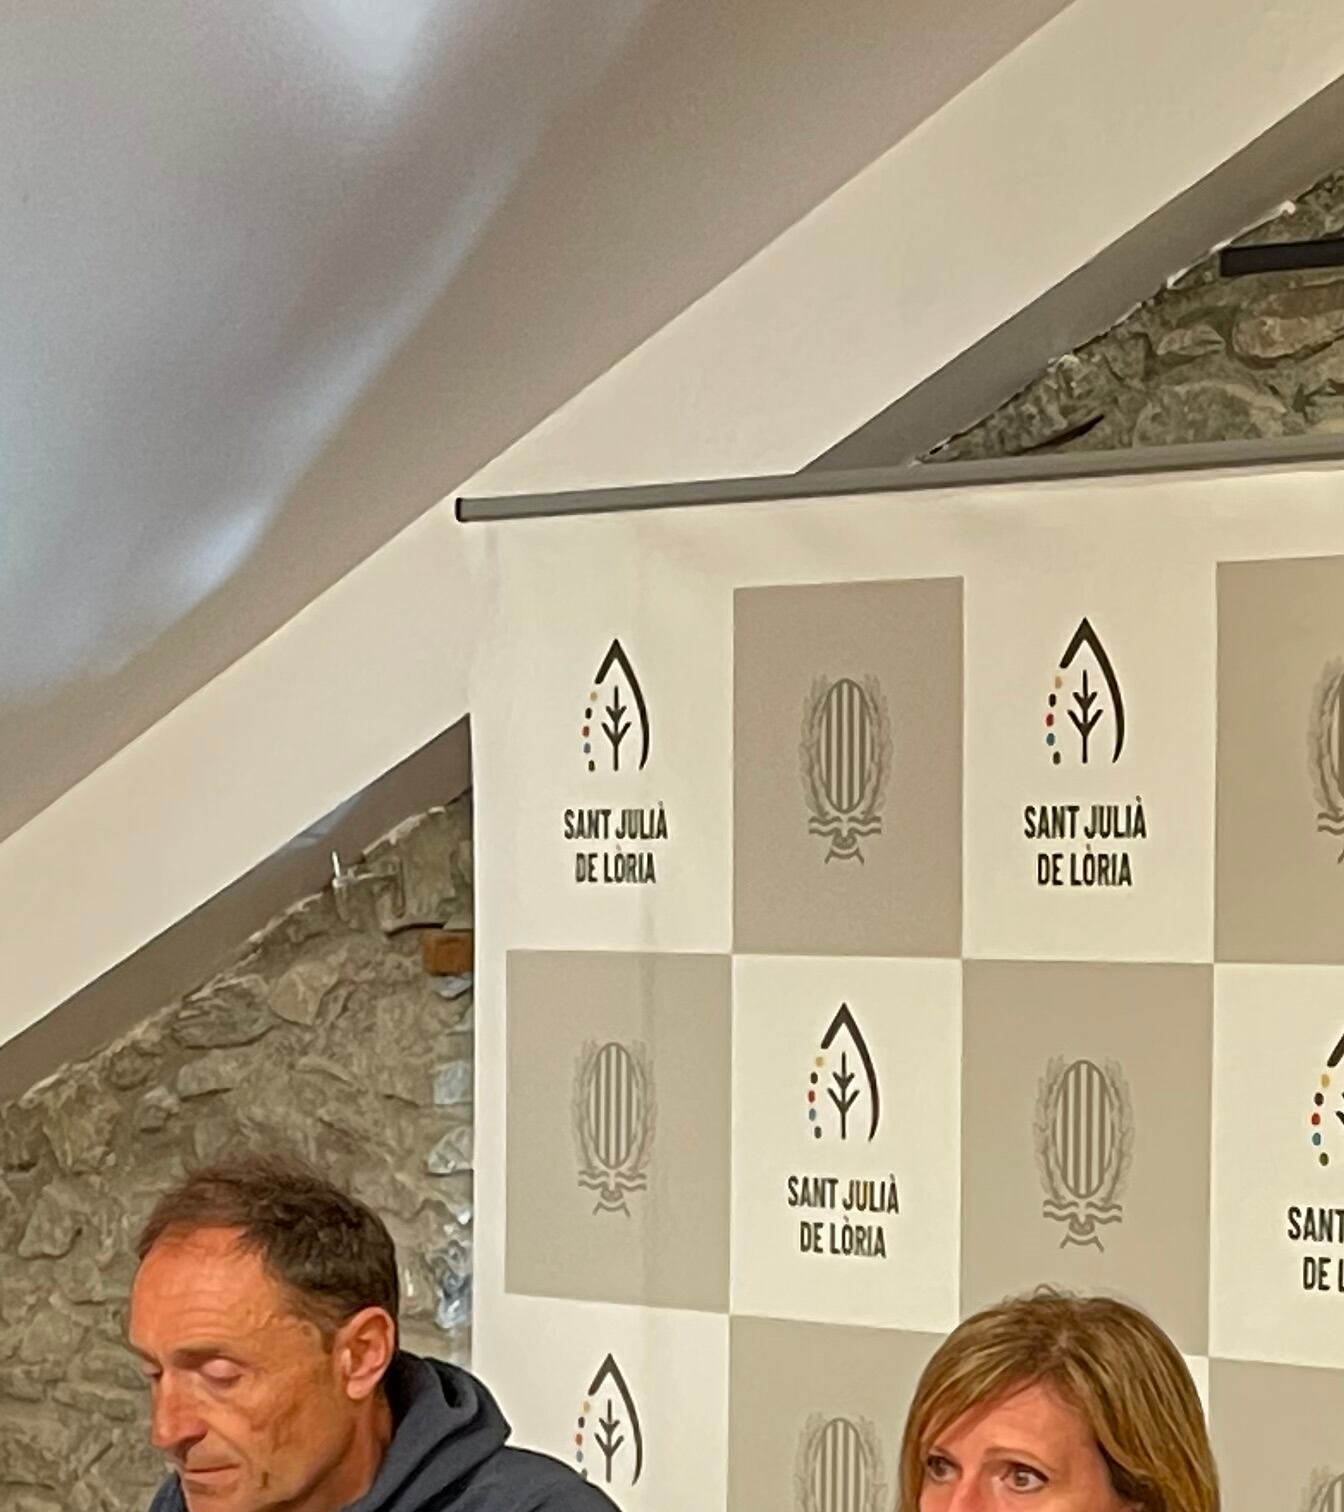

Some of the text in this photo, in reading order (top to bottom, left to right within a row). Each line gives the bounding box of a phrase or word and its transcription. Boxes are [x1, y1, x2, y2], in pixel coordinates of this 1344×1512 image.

[563, 800, 669, 842] SANT JULIÀ
[1023, 795, 1148, 841] SANT JULIÀ
[574, 844, 657, 886] DE LÒRIA
[1036, 844, 1134, 889] DE LÒRIA
[786, 1171, 900, 1216] SANT JULIÀ
[798, 1216, 888, 1259] DE LÒRIA
[1302, 1255, 1331, 1292] DE
